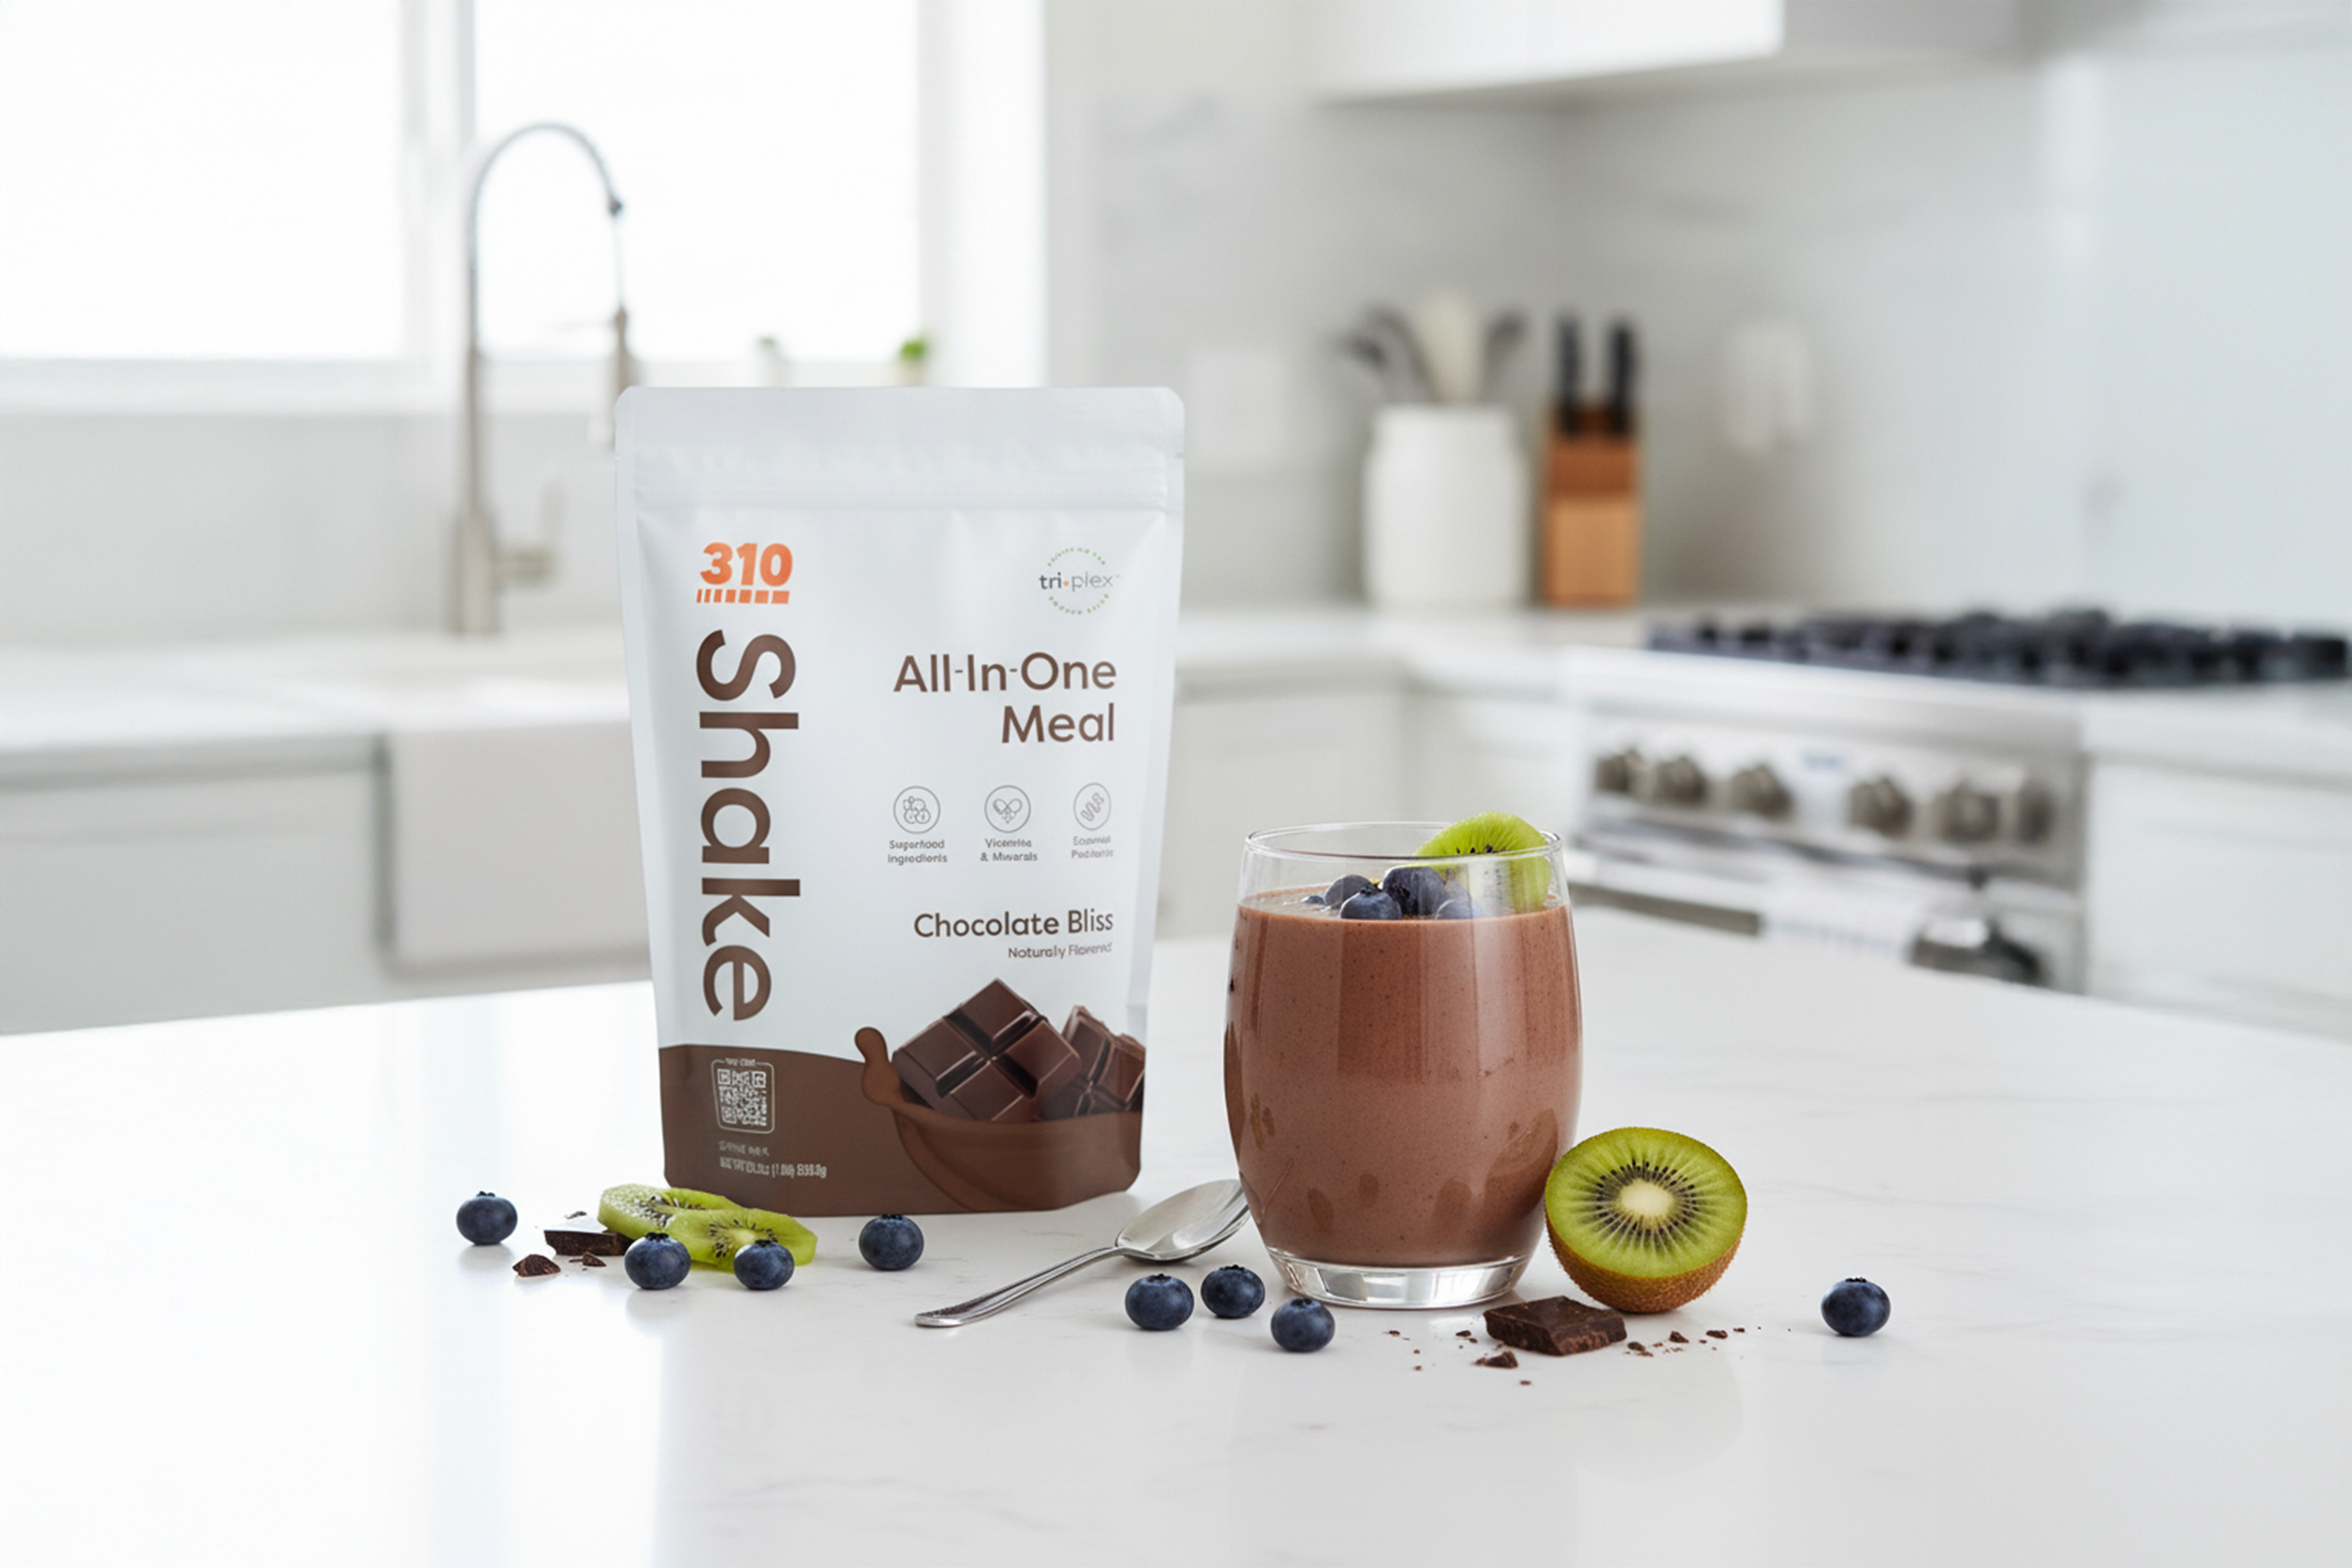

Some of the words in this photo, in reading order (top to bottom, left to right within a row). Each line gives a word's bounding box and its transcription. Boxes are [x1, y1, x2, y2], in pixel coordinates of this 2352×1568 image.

[700, 542, 793, 586] 310
[894, 652, 1117, 693] All-In-One
[1002, 703, 1115, 744] Meal
[696, 629, 801, 1020] Shake
[914, 911, 1059, 938] Chocolate
[1068, 908, 1114, 934] Bliss
